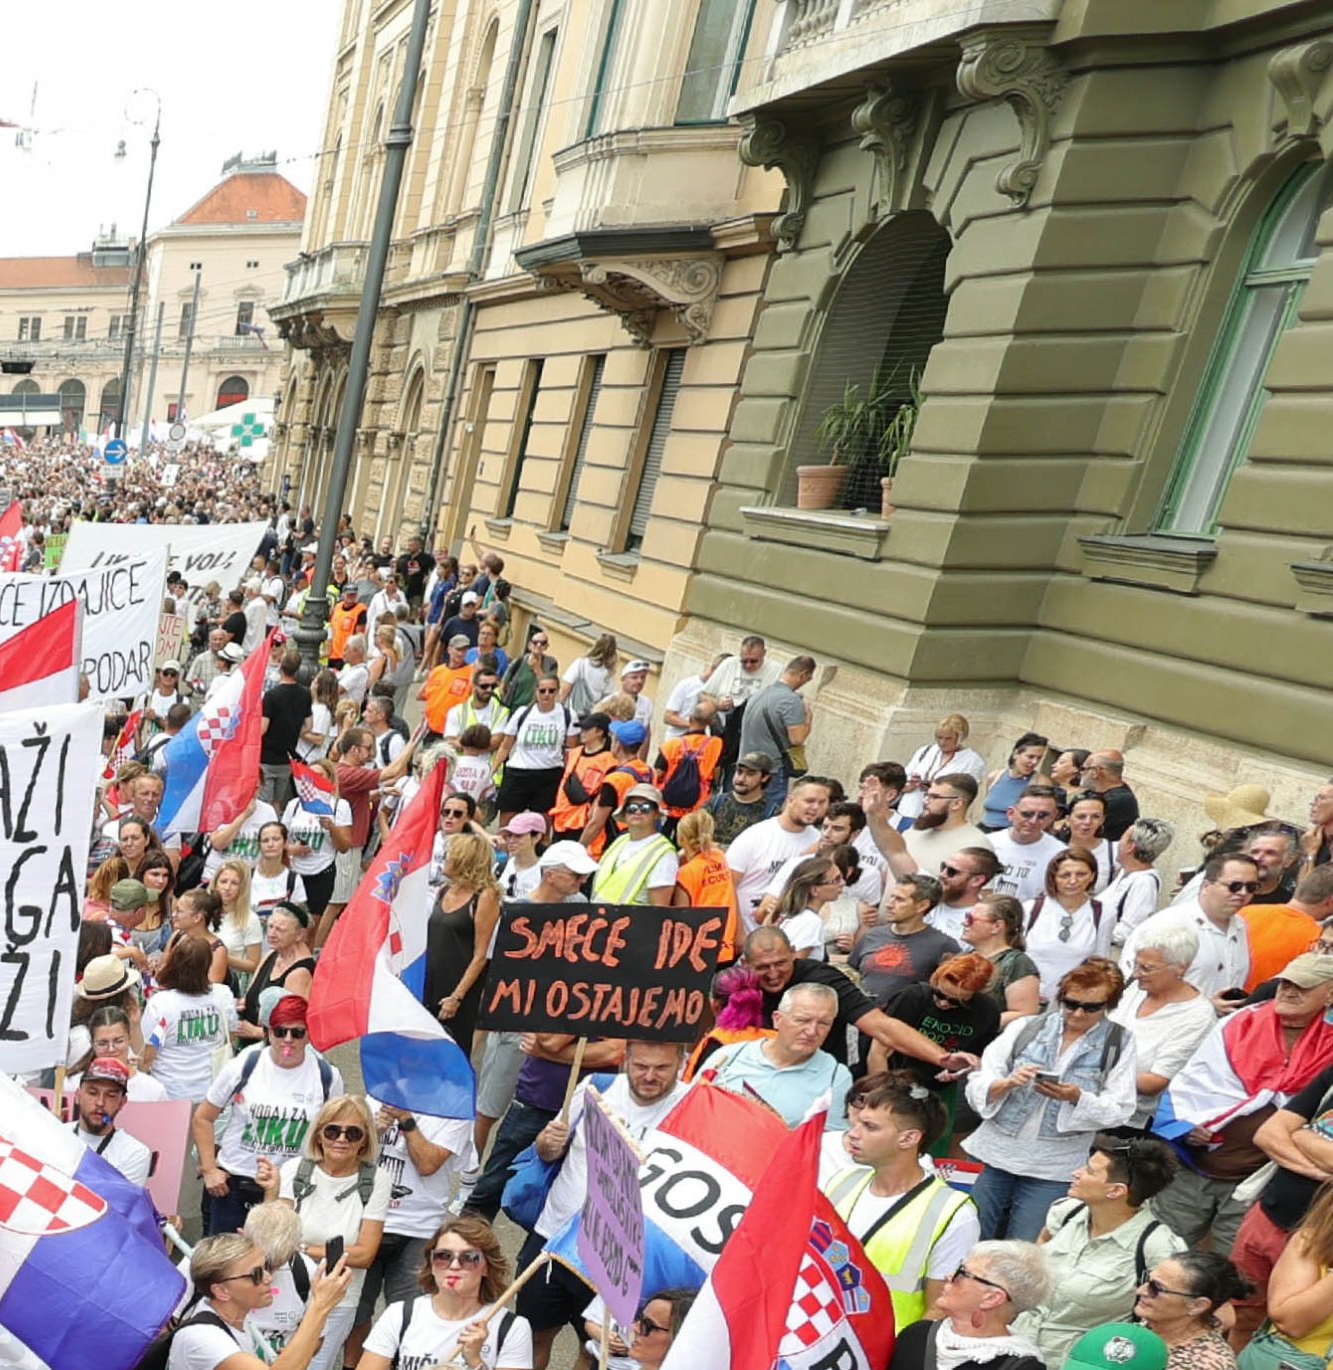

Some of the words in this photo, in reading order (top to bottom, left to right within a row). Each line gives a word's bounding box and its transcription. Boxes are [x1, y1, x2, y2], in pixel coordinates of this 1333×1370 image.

[655, 917, 722, 972] IDE
[488, 978, 537, 1015] MI
[545, 980, 704, 1030] OSTAJEMO
